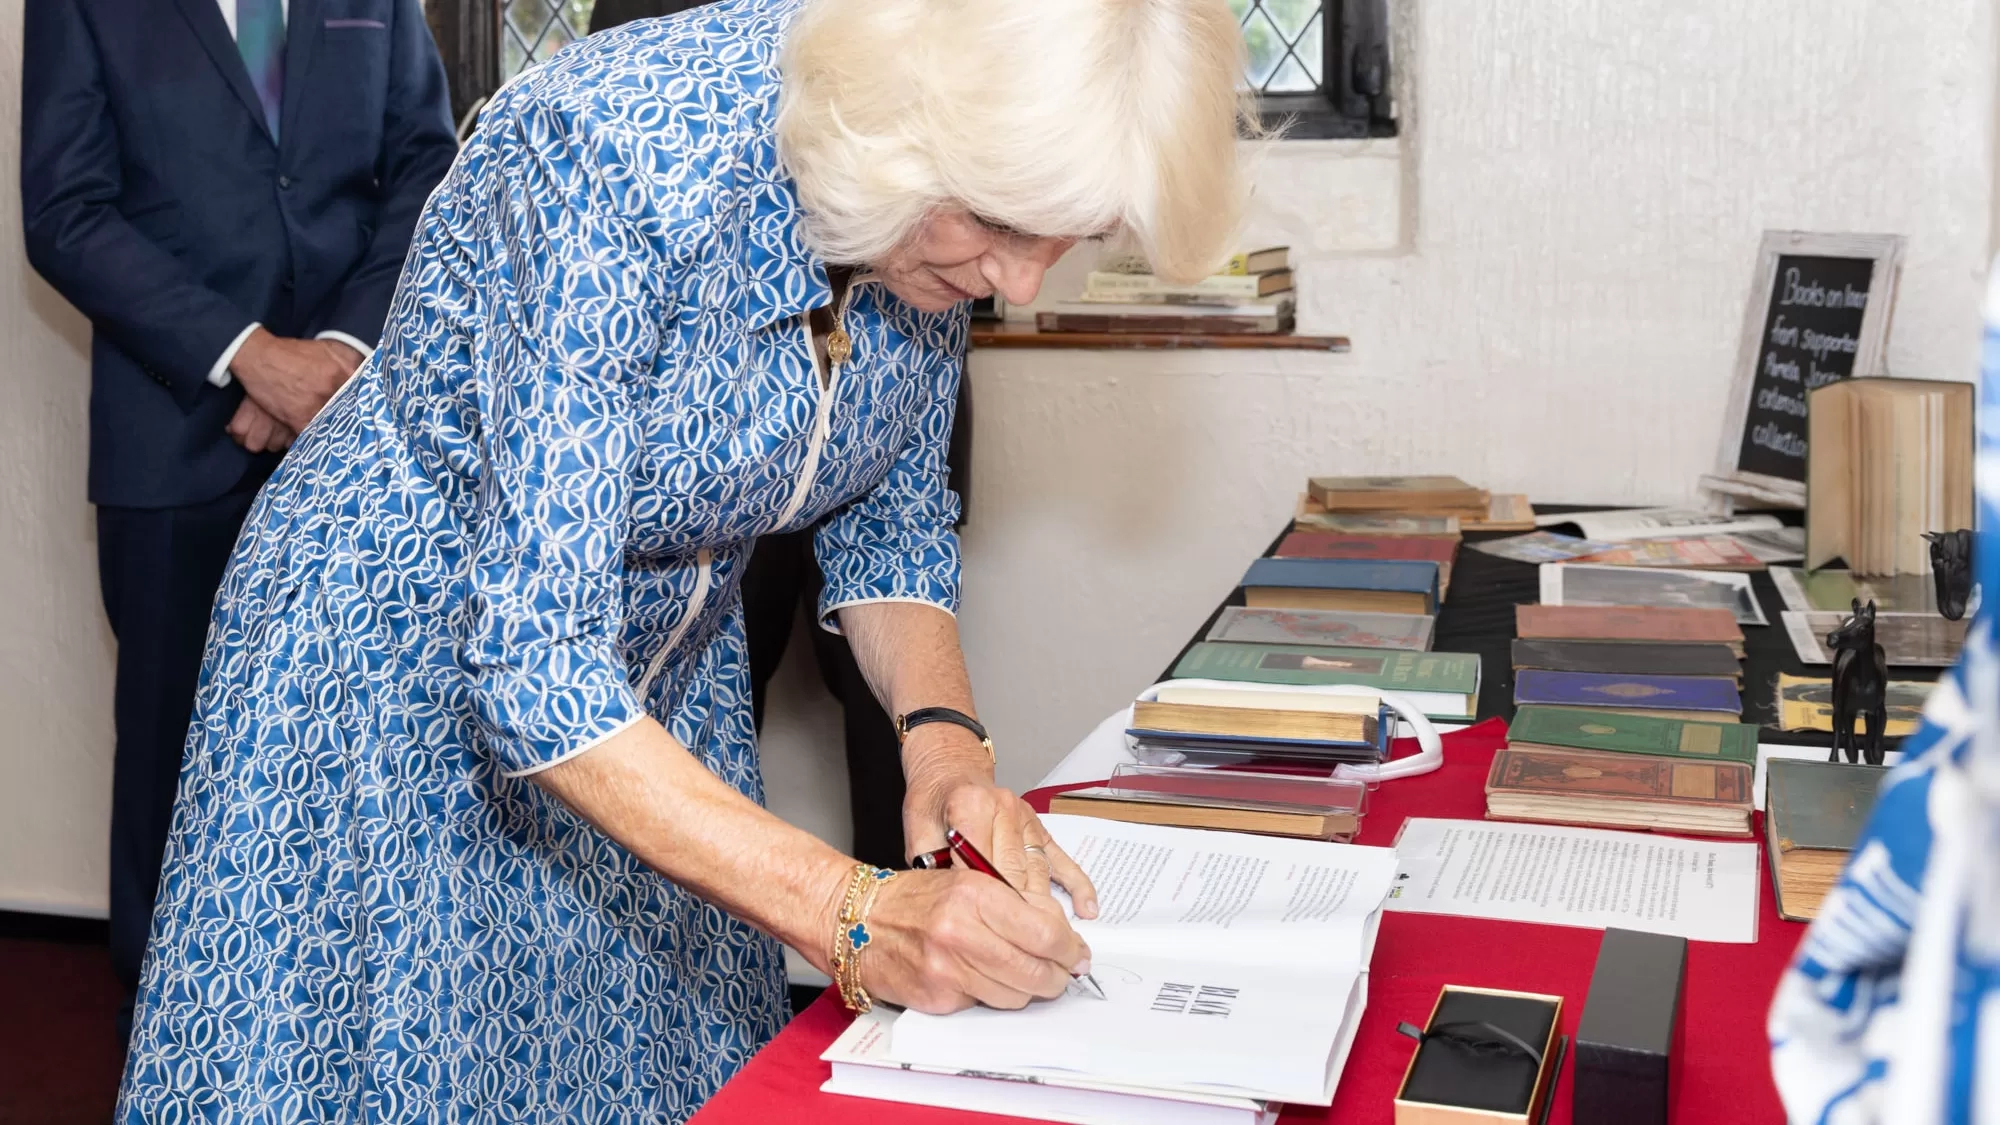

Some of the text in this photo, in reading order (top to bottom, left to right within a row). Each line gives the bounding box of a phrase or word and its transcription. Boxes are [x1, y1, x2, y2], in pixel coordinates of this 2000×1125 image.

[1780, 267, 1826, 307] Books
[1826, 289, 1843, 308] on
[1804, 361, 1841, 388] Jon
[1758, 386, 1807, 417] extensi
[1752, 421, 1808, 458] collectio
[1150, 982, 1195, 1014] BEAUTY
[1188, 985, 1240, 1019] BLACK
